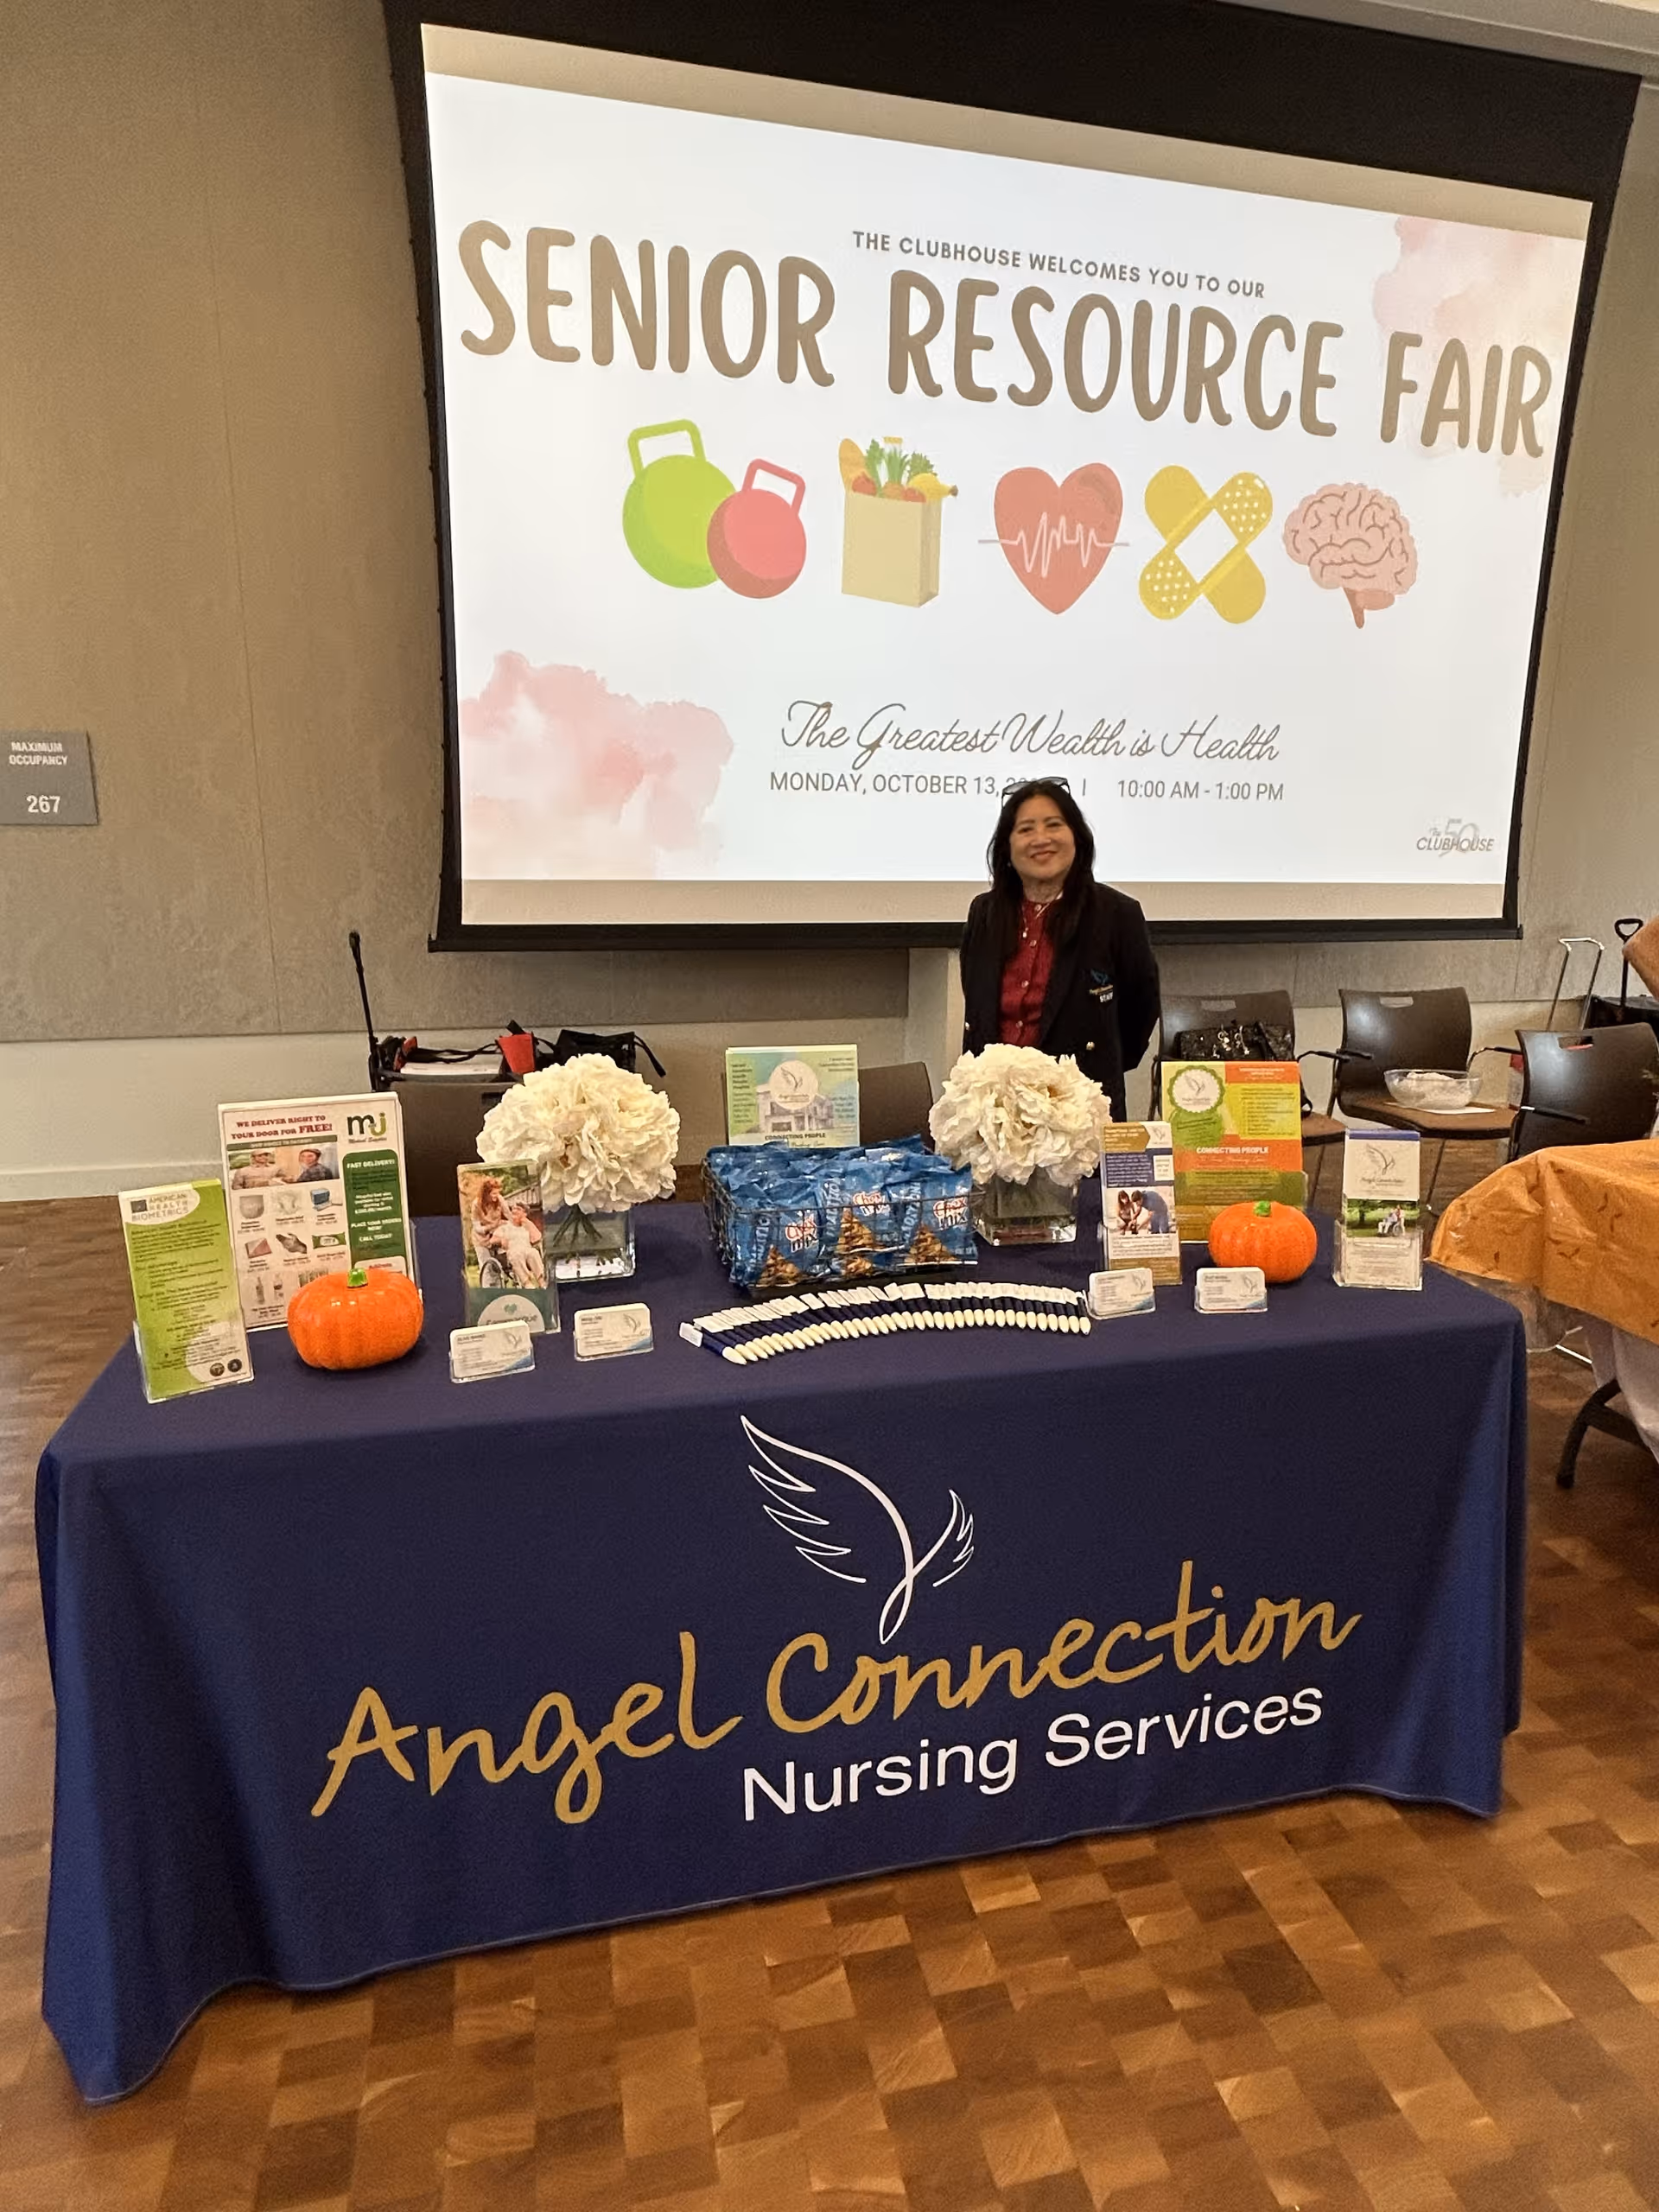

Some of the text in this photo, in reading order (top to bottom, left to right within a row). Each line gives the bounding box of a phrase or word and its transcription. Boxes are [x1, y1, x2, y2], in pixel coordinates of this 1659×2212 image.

[853, 230, 1266, 299] THE CLUBHOUSE WELCOMES YOU TO OUR
[458, 219, 1551, 459] SENIOR RESOURCE FAIR
[11, 741, 63, 753] MAXIMUM
[780, 700, 1281, 771] The Greatest Wealth is Health
[9, 754, 68, 766] OCCUPANCY
[770, 772, 868, 796] MONDAY,
[872, 774, 968, 795] OCTOBER
[974, 776, 1000, 798] 13,
[1117, 780, 1166, 798] 10:00
[1170, 781, 1199, 799] AM
[1215, 783, 1251, 801] 1:00
[1256, 784, 1285, 801] PM
[26, 795, 60, 814] 267
[1416, 836, 1495, 852] CLUBHOUSE
[231, 1122, 334, 1140] YOUR DOOR FOR FREE!
[251, 1118, 287, 1128] DELIVER
[288, 1116, 313, 1124] RIGHT
[313, 1559, 1363, 1826] Angel Connection
[744, 1686, 1325, 1821] Nursing Services
